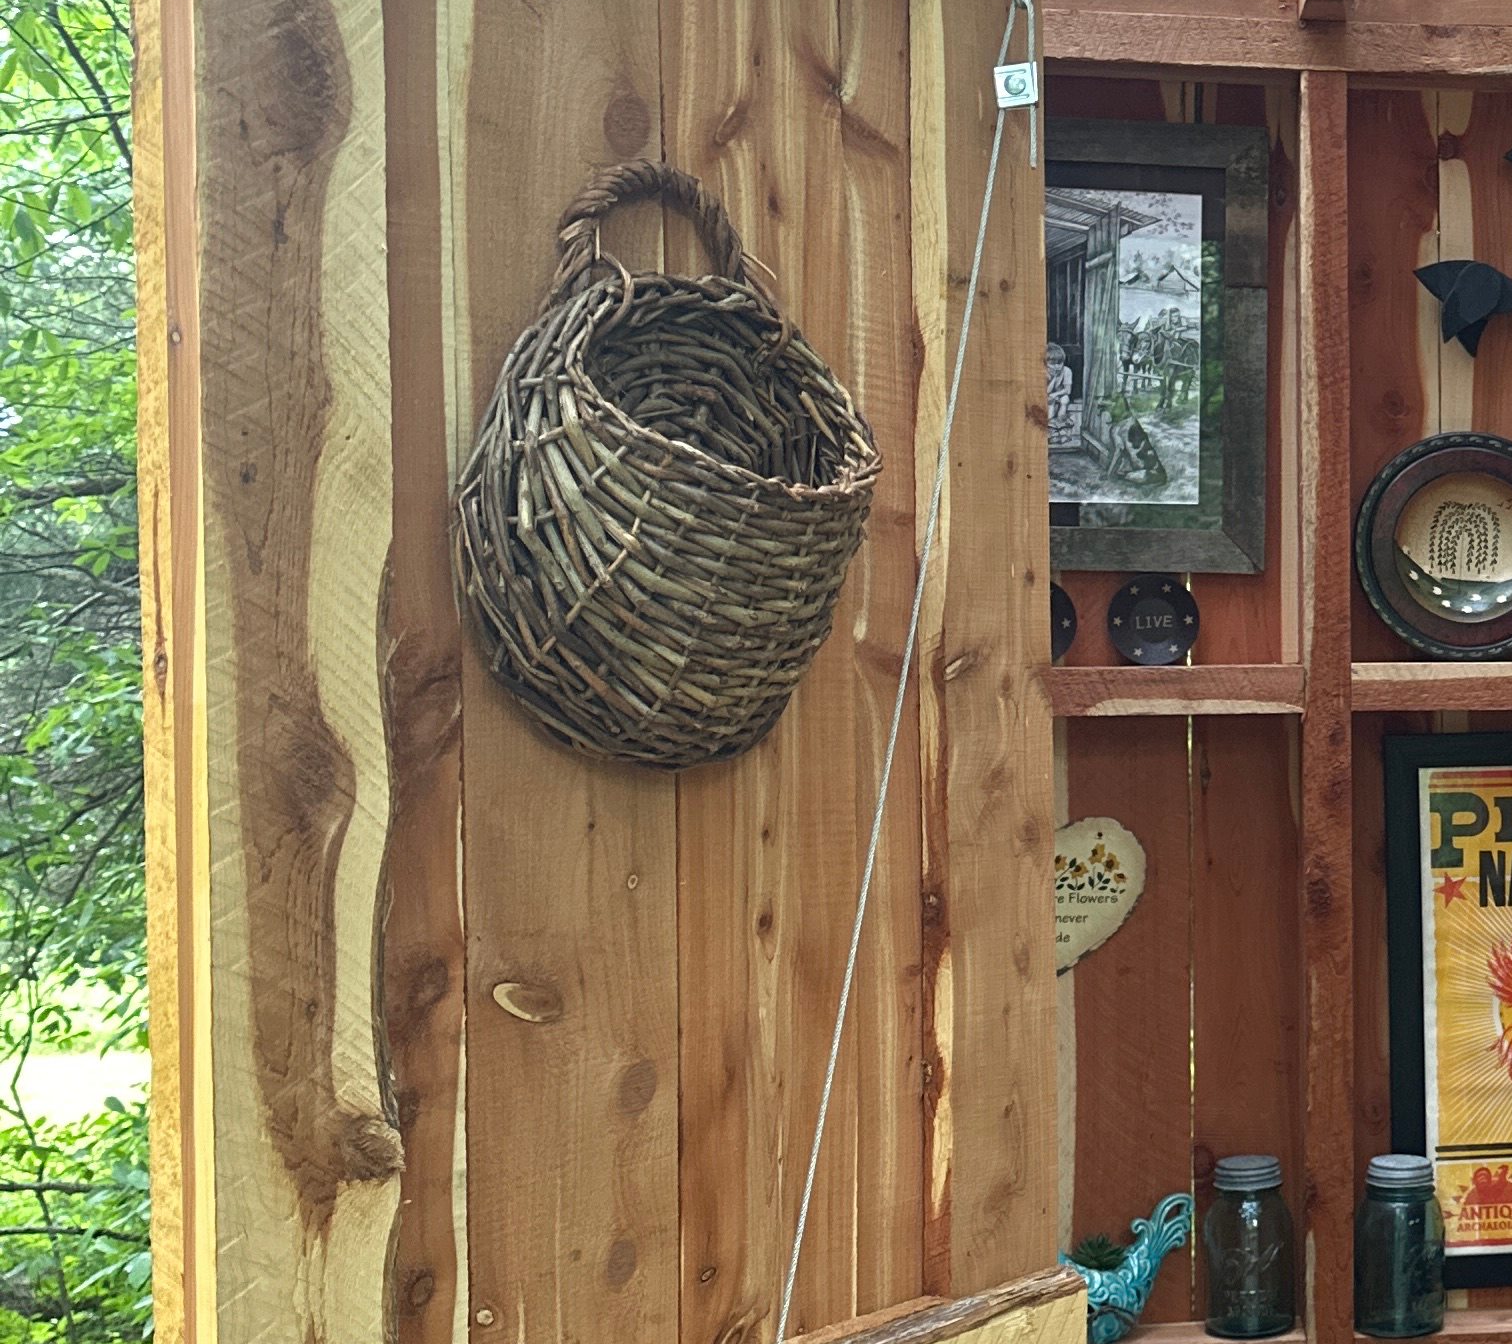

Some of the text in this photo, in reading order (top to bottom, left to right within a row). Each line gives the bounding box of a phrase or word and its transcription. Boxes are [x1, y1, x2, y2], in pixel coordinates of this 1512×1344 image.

[1135, 615, 1173, 630] LIVE
[1068, 892, 1119, 904] Flowers
[1055, 914, 1089, 924] never
